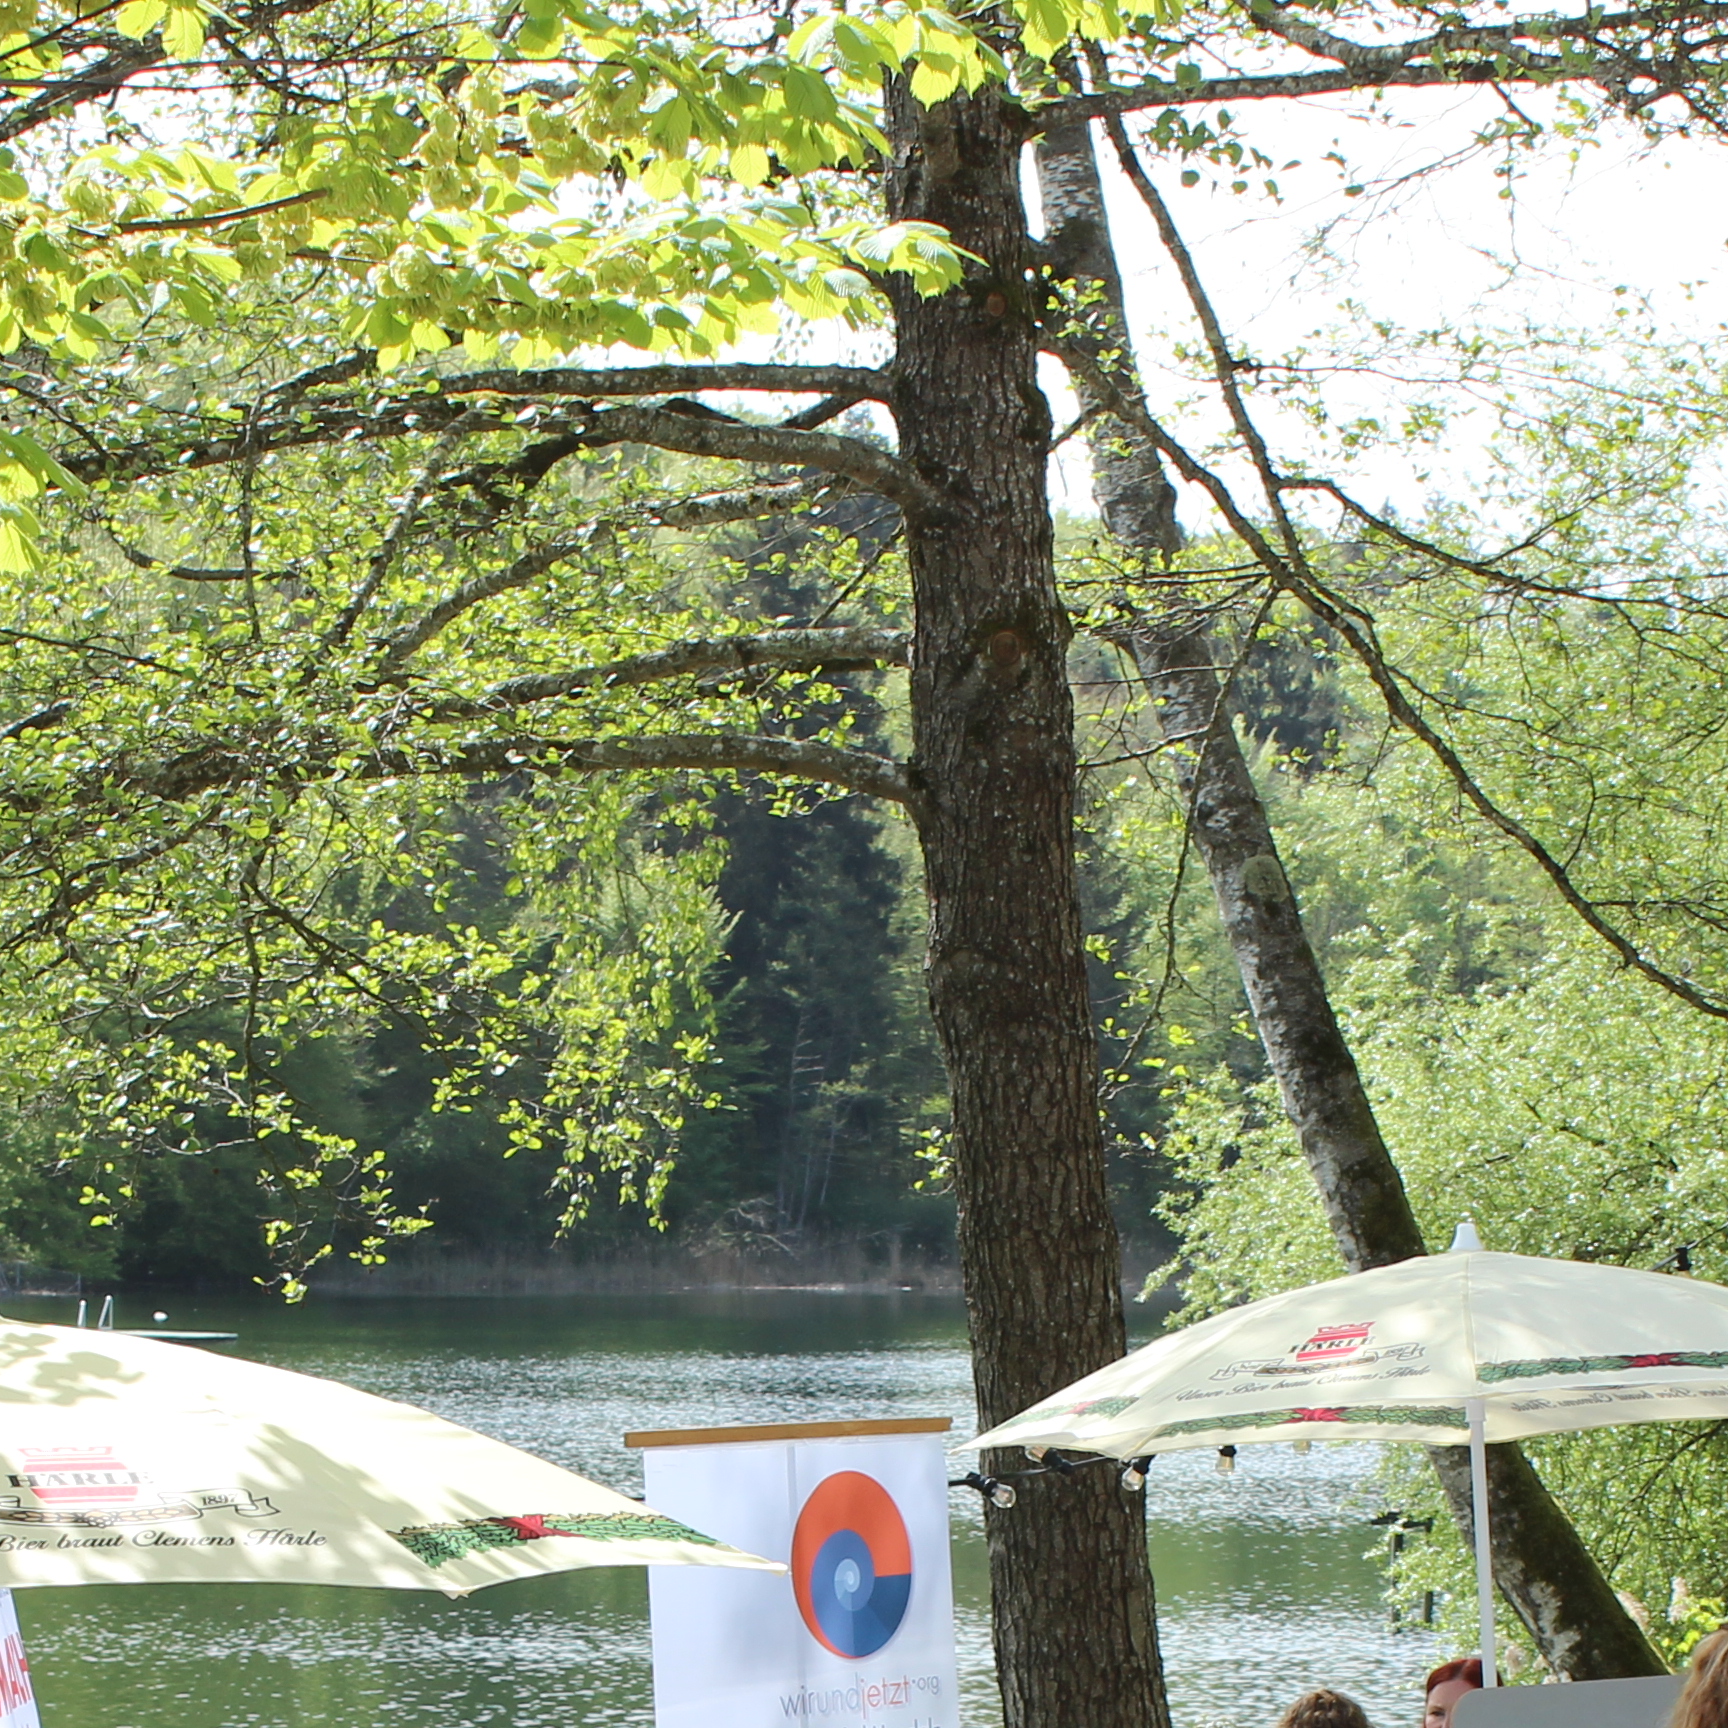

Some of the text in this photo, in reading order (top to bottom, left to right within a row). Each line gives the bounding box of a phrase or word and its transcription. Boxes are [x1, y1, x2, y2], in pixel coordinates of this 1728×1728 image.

[202, 1492, 238, 1507] 1897
[57, 1533, 123, 1549] braut
[132, 1530, 235, 1547] Clemens
[242, 1528, 328, 1547] Härle
